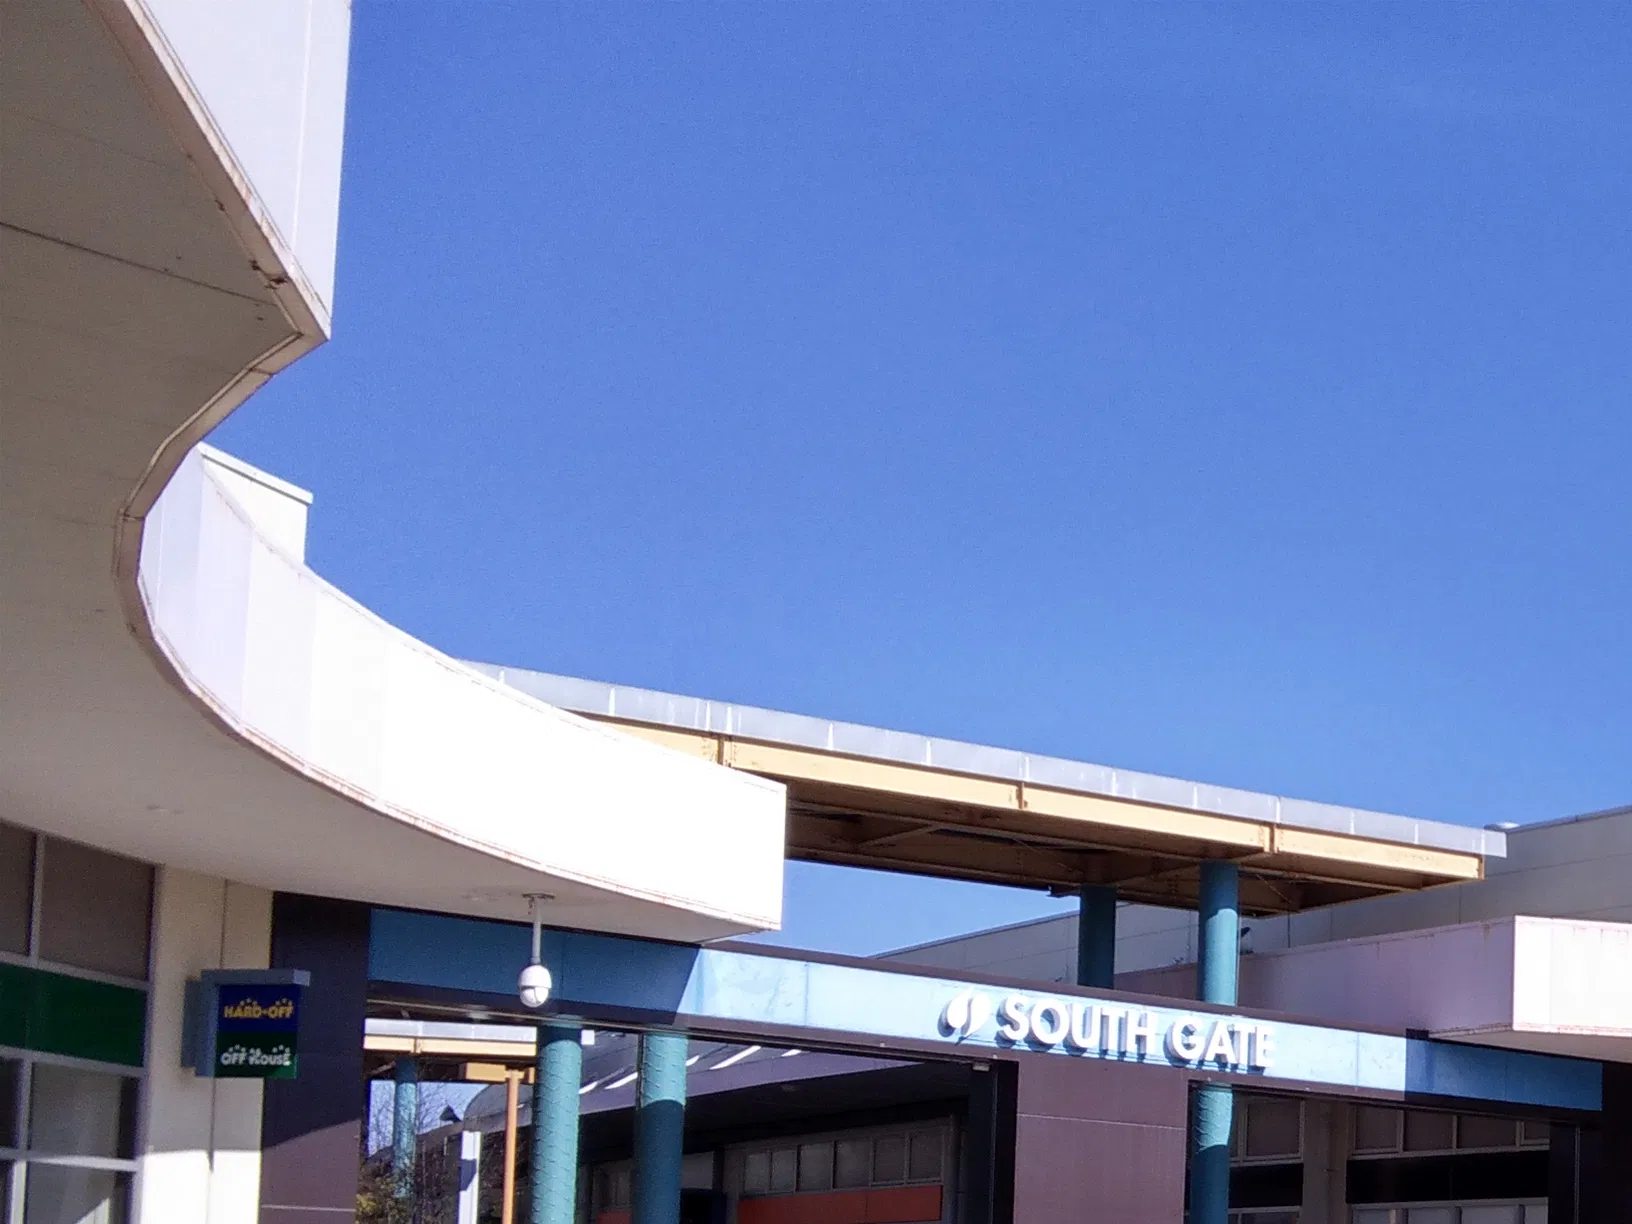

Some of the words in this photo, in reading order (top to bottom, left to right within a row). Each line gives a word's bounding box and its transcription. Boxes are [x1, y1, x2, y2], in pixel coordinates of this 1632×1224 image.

[1000, 996, 1158, 1056] SOUTH
[1171, 1014, 1276, 1067] GATE
[221, 1052, 246, 1066] OFF
